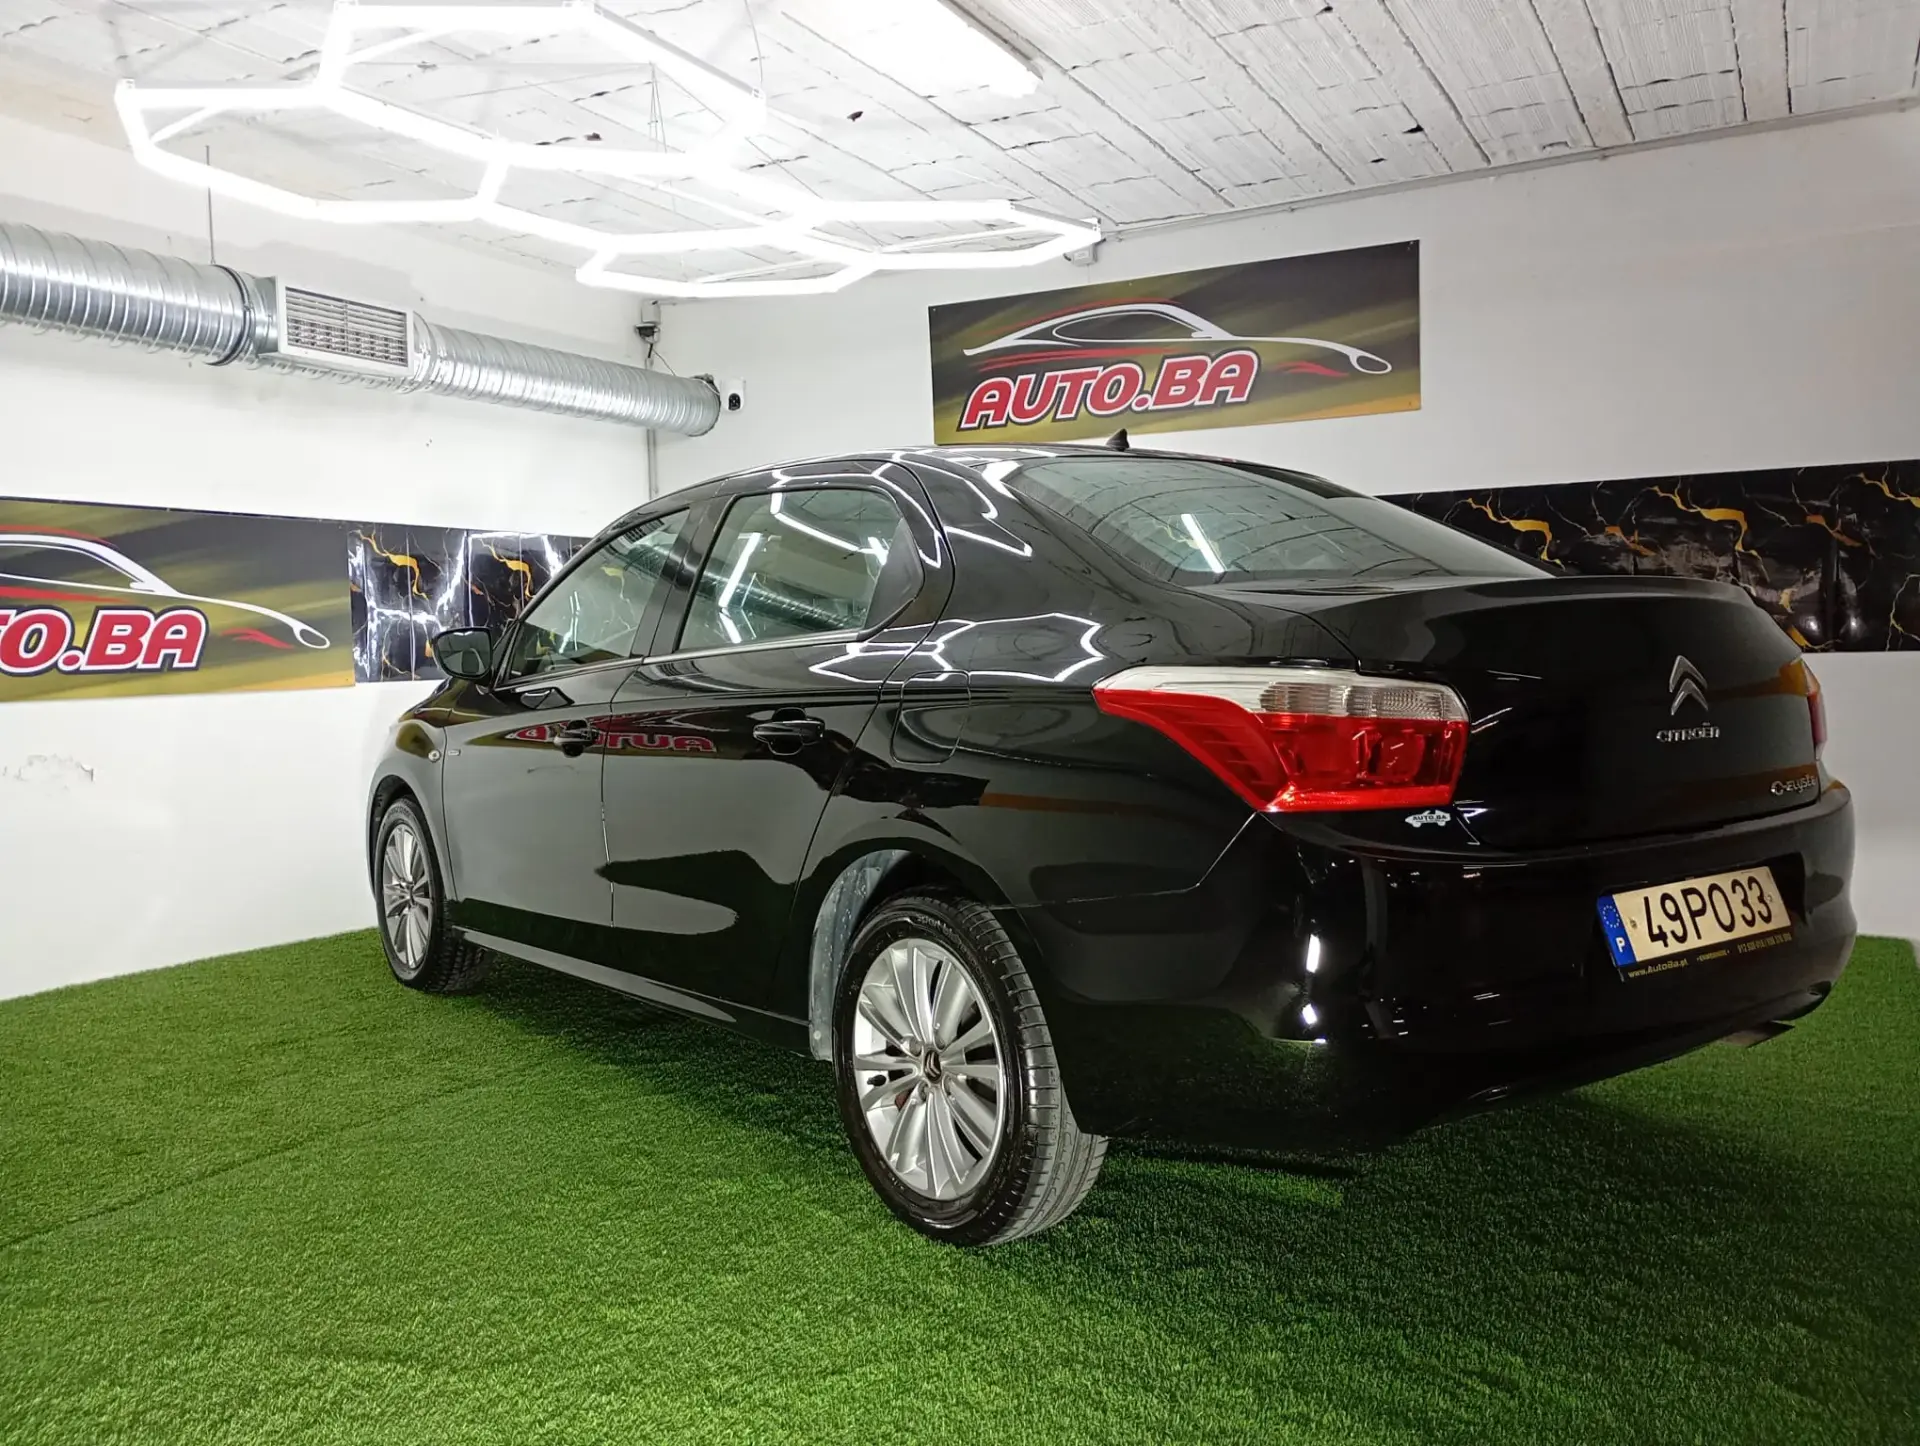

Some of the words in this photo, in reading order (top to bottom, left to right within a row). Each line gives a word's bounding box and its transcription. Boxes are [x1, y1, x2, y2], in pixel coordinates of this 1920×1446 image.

[961, 350, 1258, 429] AUTO.BA
[1615, 937, 1626, 953] P
[1643, 875, 1773, 948] 49PO33
